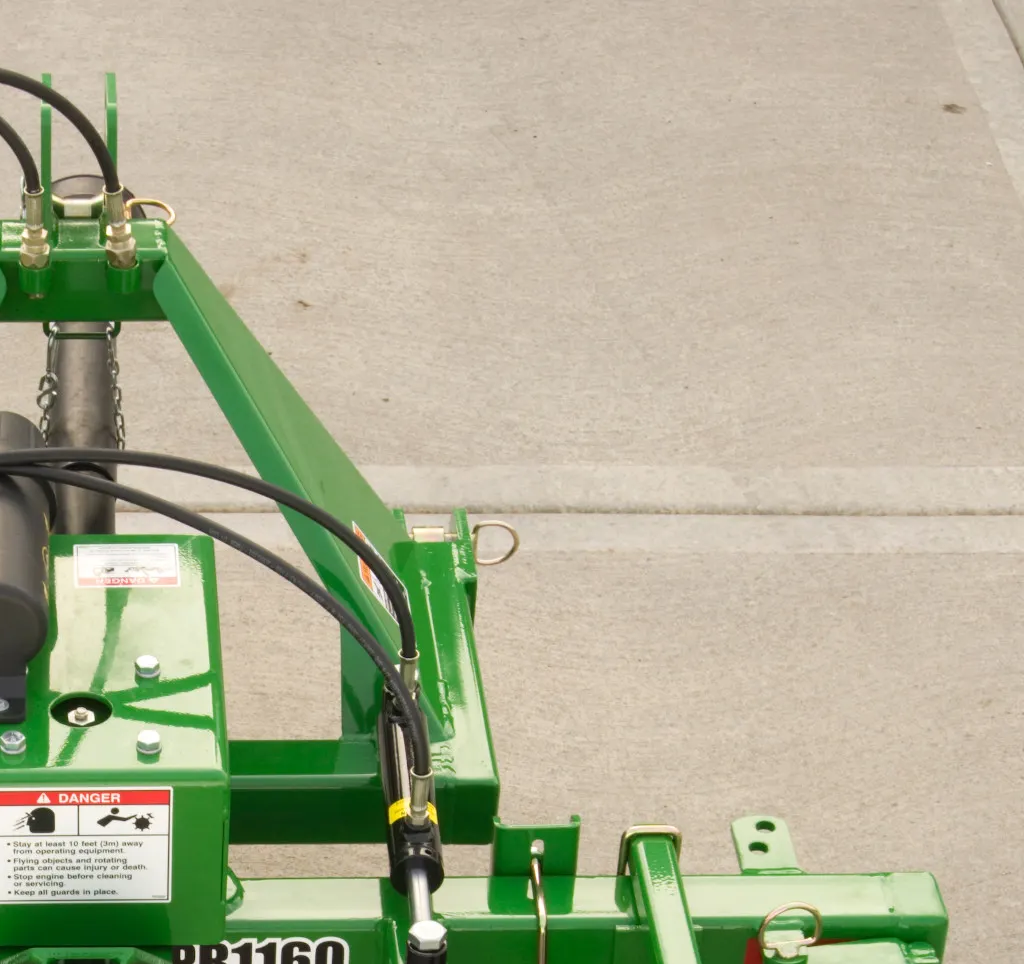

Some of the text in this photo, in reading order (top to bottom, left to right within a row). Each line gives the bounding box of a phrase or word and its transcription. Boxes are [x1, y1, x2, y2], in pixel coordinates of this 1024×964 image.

[59, 793, 121, 804] DANGER
[100, 840, 119, 848] (3m)
[35, 848, 76, 856] operating
[42, 857, 73, 865] objects
[13, 873, 33, 881] Stop
[93, 888, 118, 896] place.
